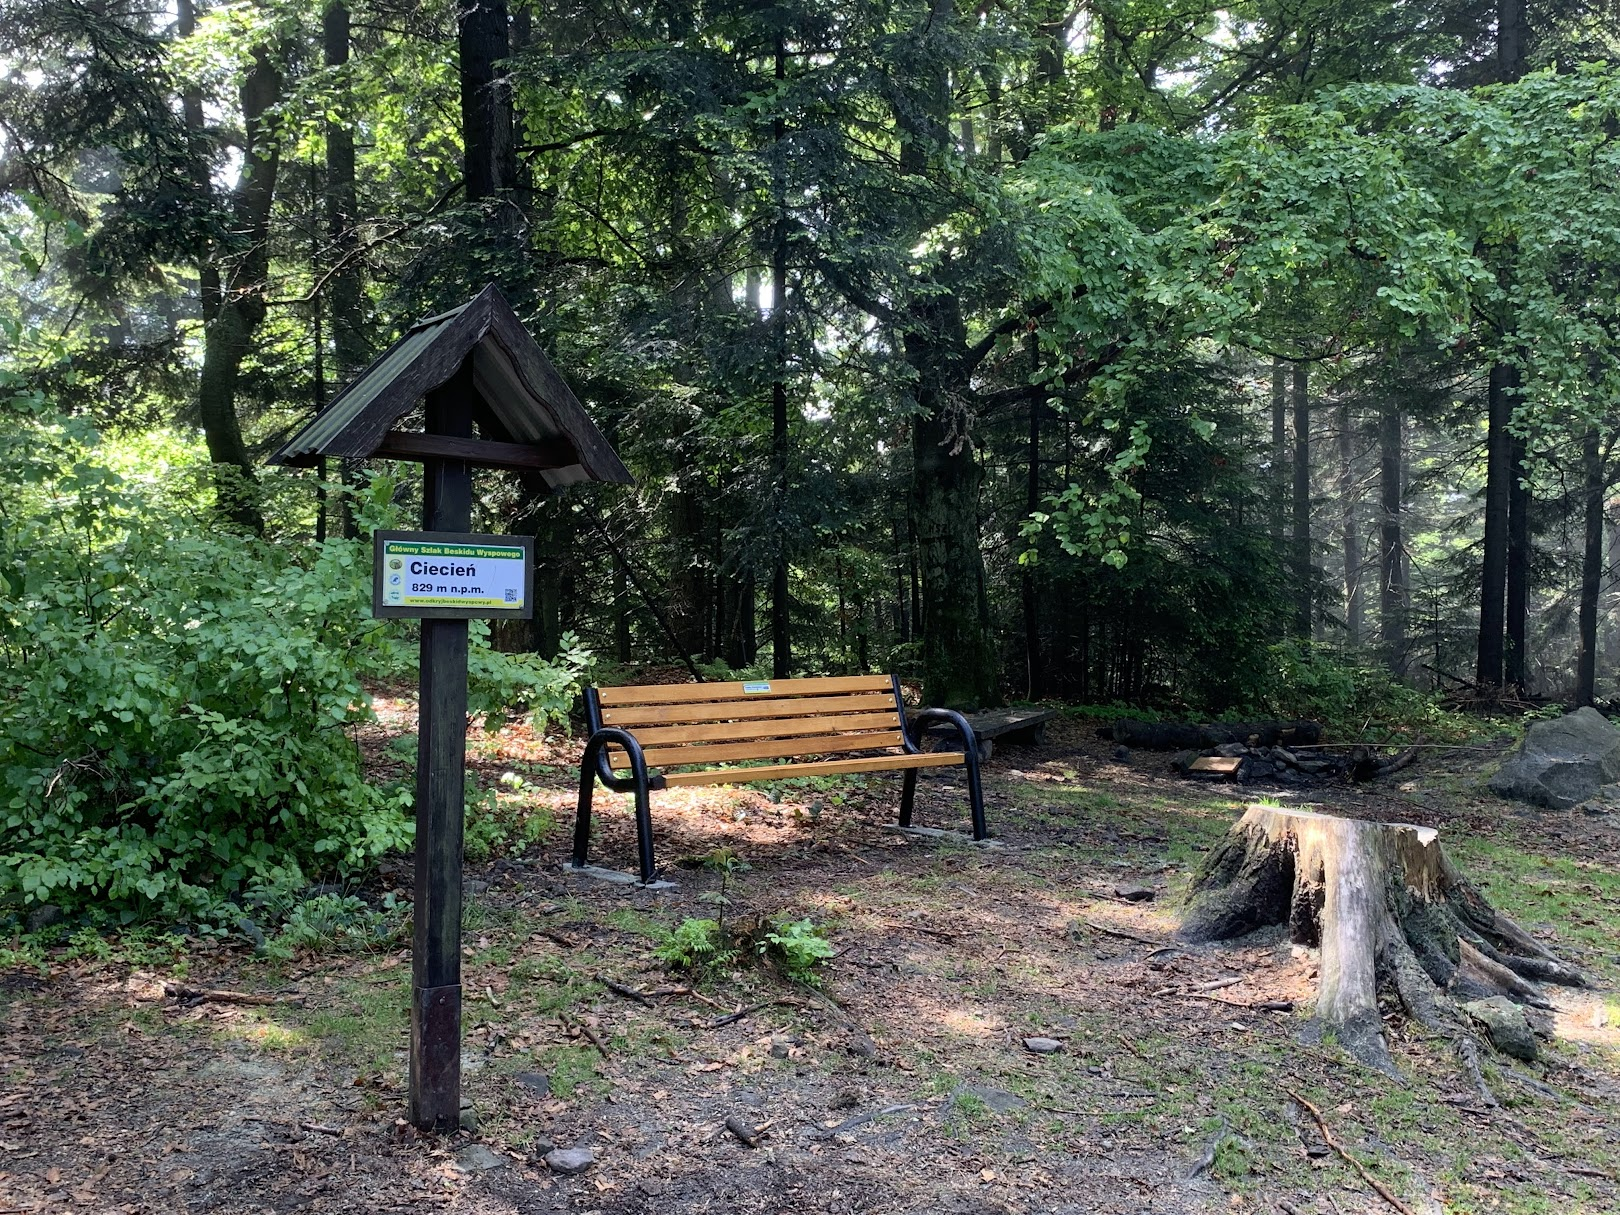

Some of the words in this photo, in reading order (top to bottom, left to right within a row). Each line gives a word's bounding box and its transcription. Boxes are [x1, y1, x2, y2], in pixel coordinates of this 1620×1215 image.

[389, 545, 419, 554] Główny
[421, 547, 442, 555] Szlak
[444, 548, 475, 556] Beskidu
[477, 549, 521, 558] Wyspowego
[410, 561, 476, 577] Ciecień
[412, 583, 433, 592] 829
[437, 585, 447, 593] m
[451, 586, 484, 595] n.p.m.
